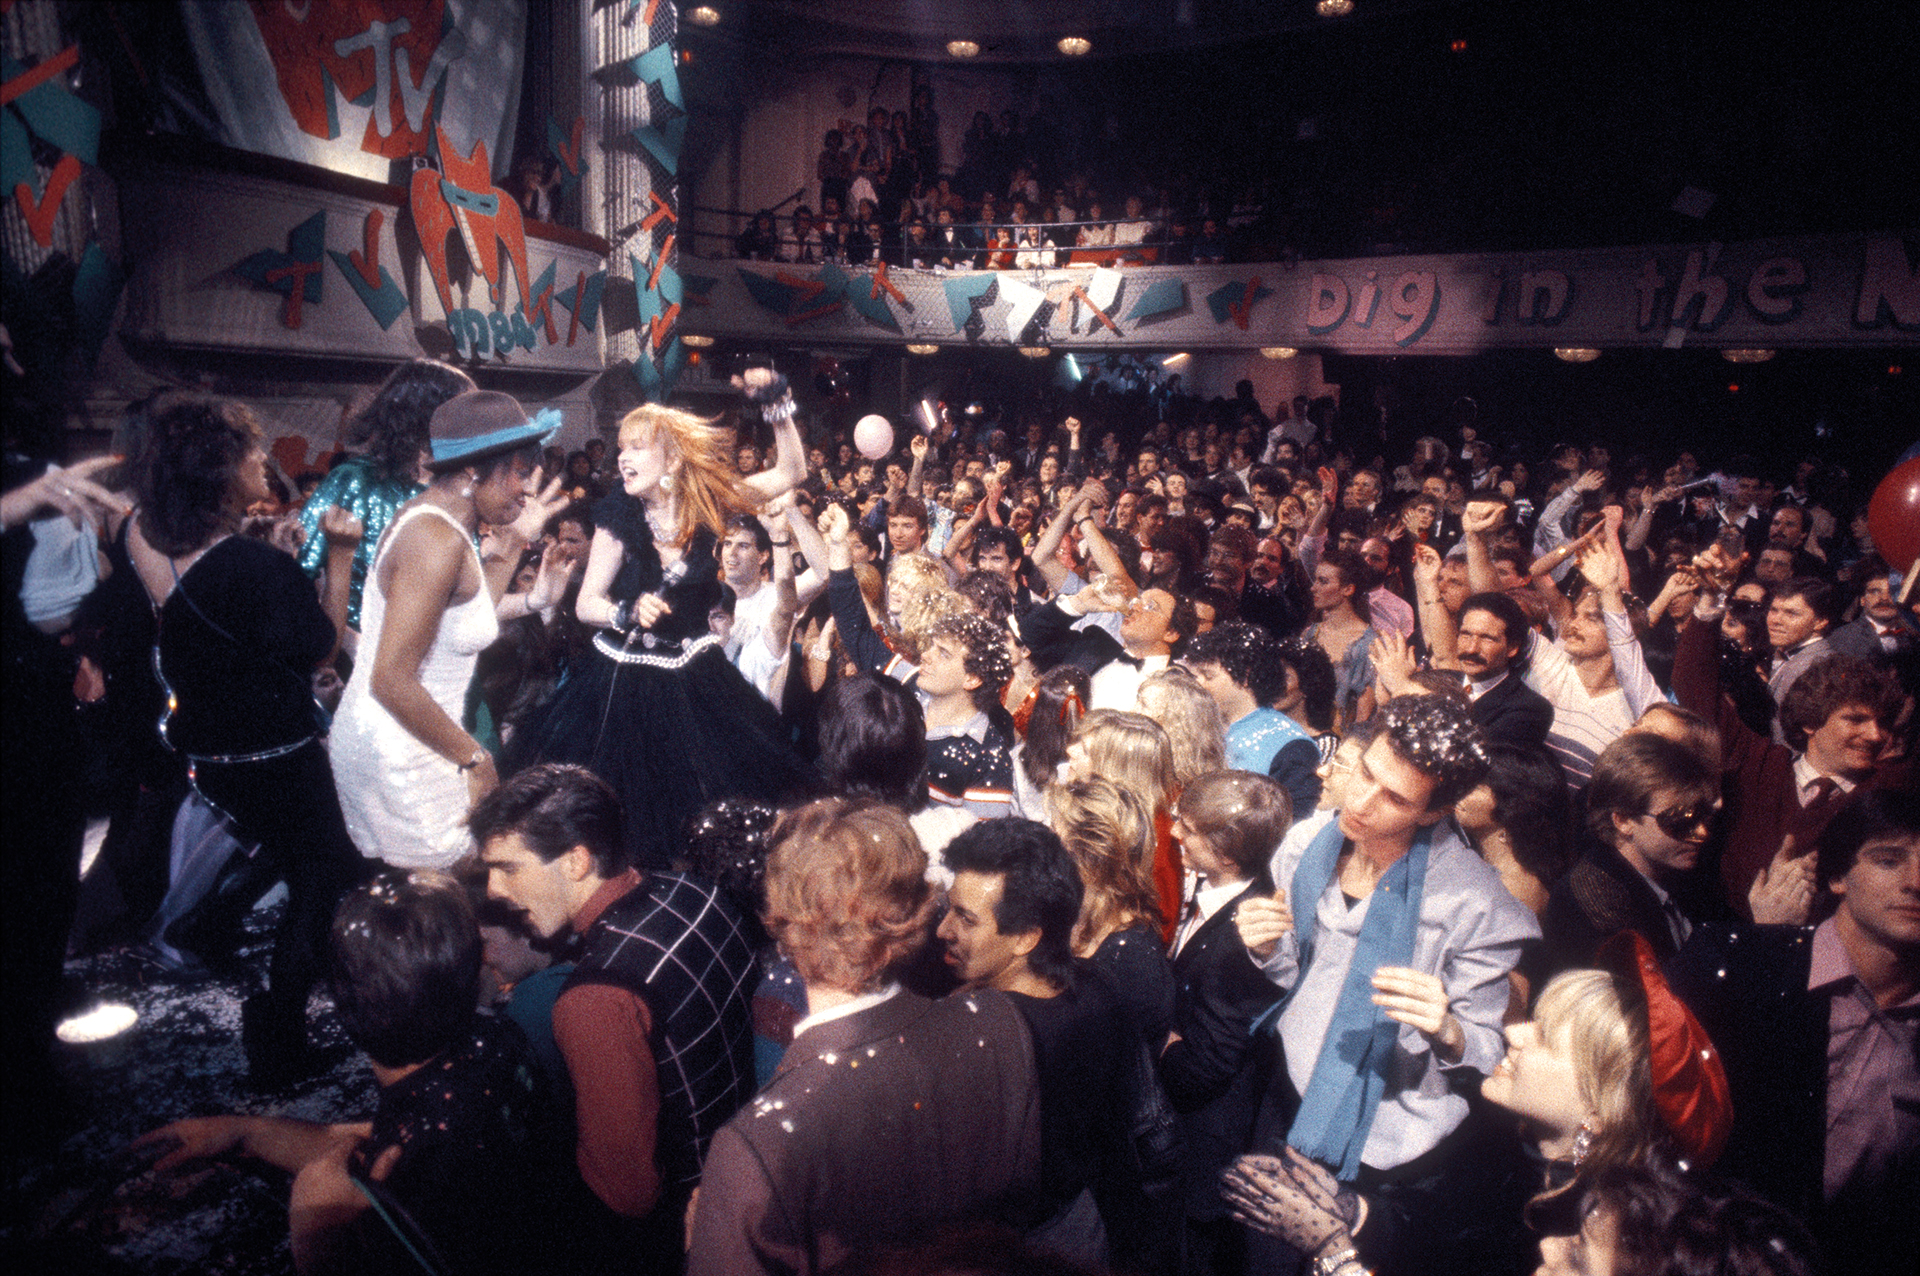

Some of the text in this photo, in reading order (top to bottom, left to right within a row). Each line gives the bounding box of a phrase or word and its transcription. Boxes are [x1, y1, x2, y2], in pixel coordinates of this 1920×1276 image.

[1307, 270, 1439, 346] Dig
[1484, 268, 1573, 327] in
[1635, 243, 1805, 333] the
